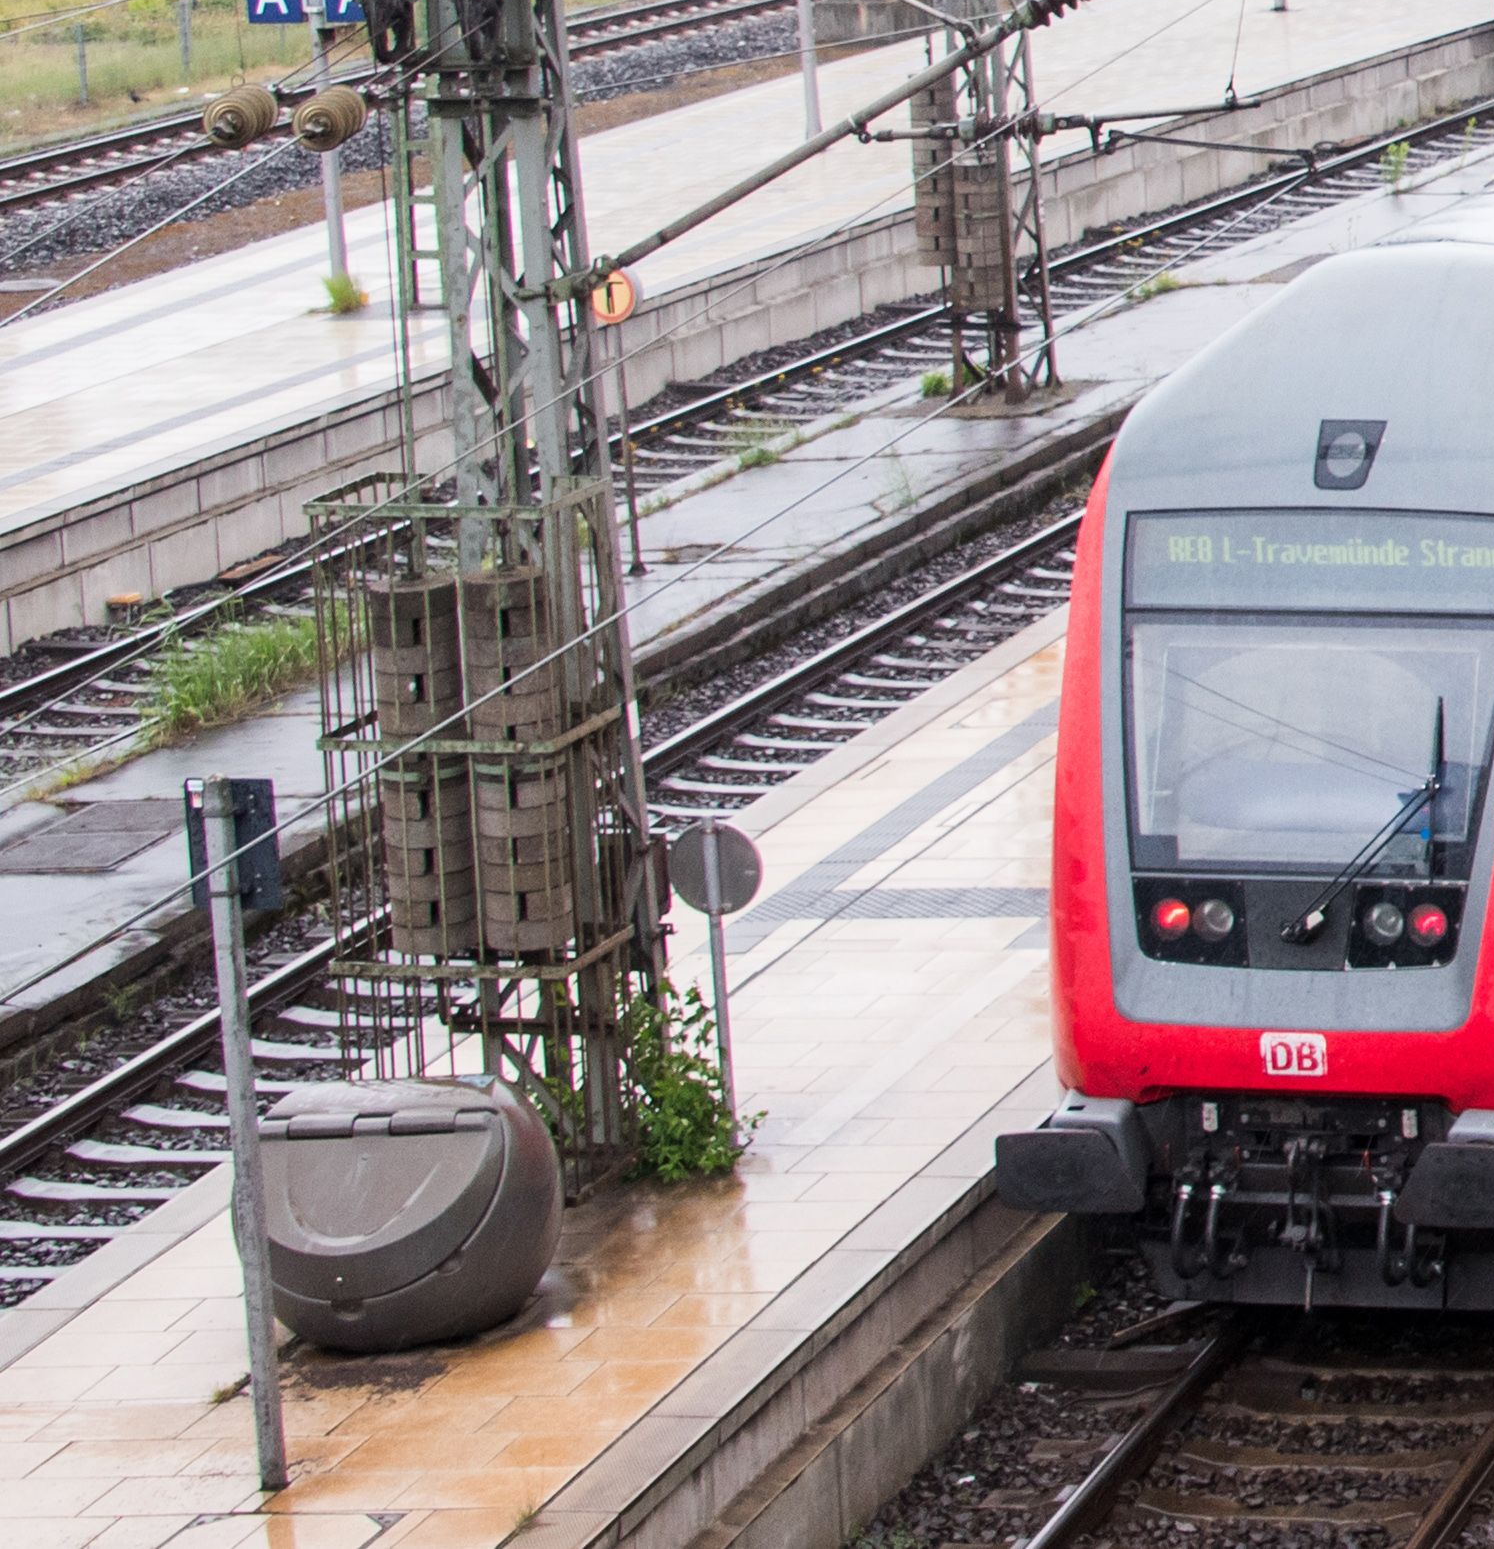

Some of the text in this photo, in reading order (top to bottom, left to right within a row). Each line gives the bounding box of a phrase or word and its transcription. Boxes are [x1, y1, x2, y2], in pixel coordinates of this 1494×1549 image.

[1168, 536, 1212, 563] RE8
[1222, 536, 1409, 566] L-Travemünde
[1271, 1041, 1319, 1072] DB
